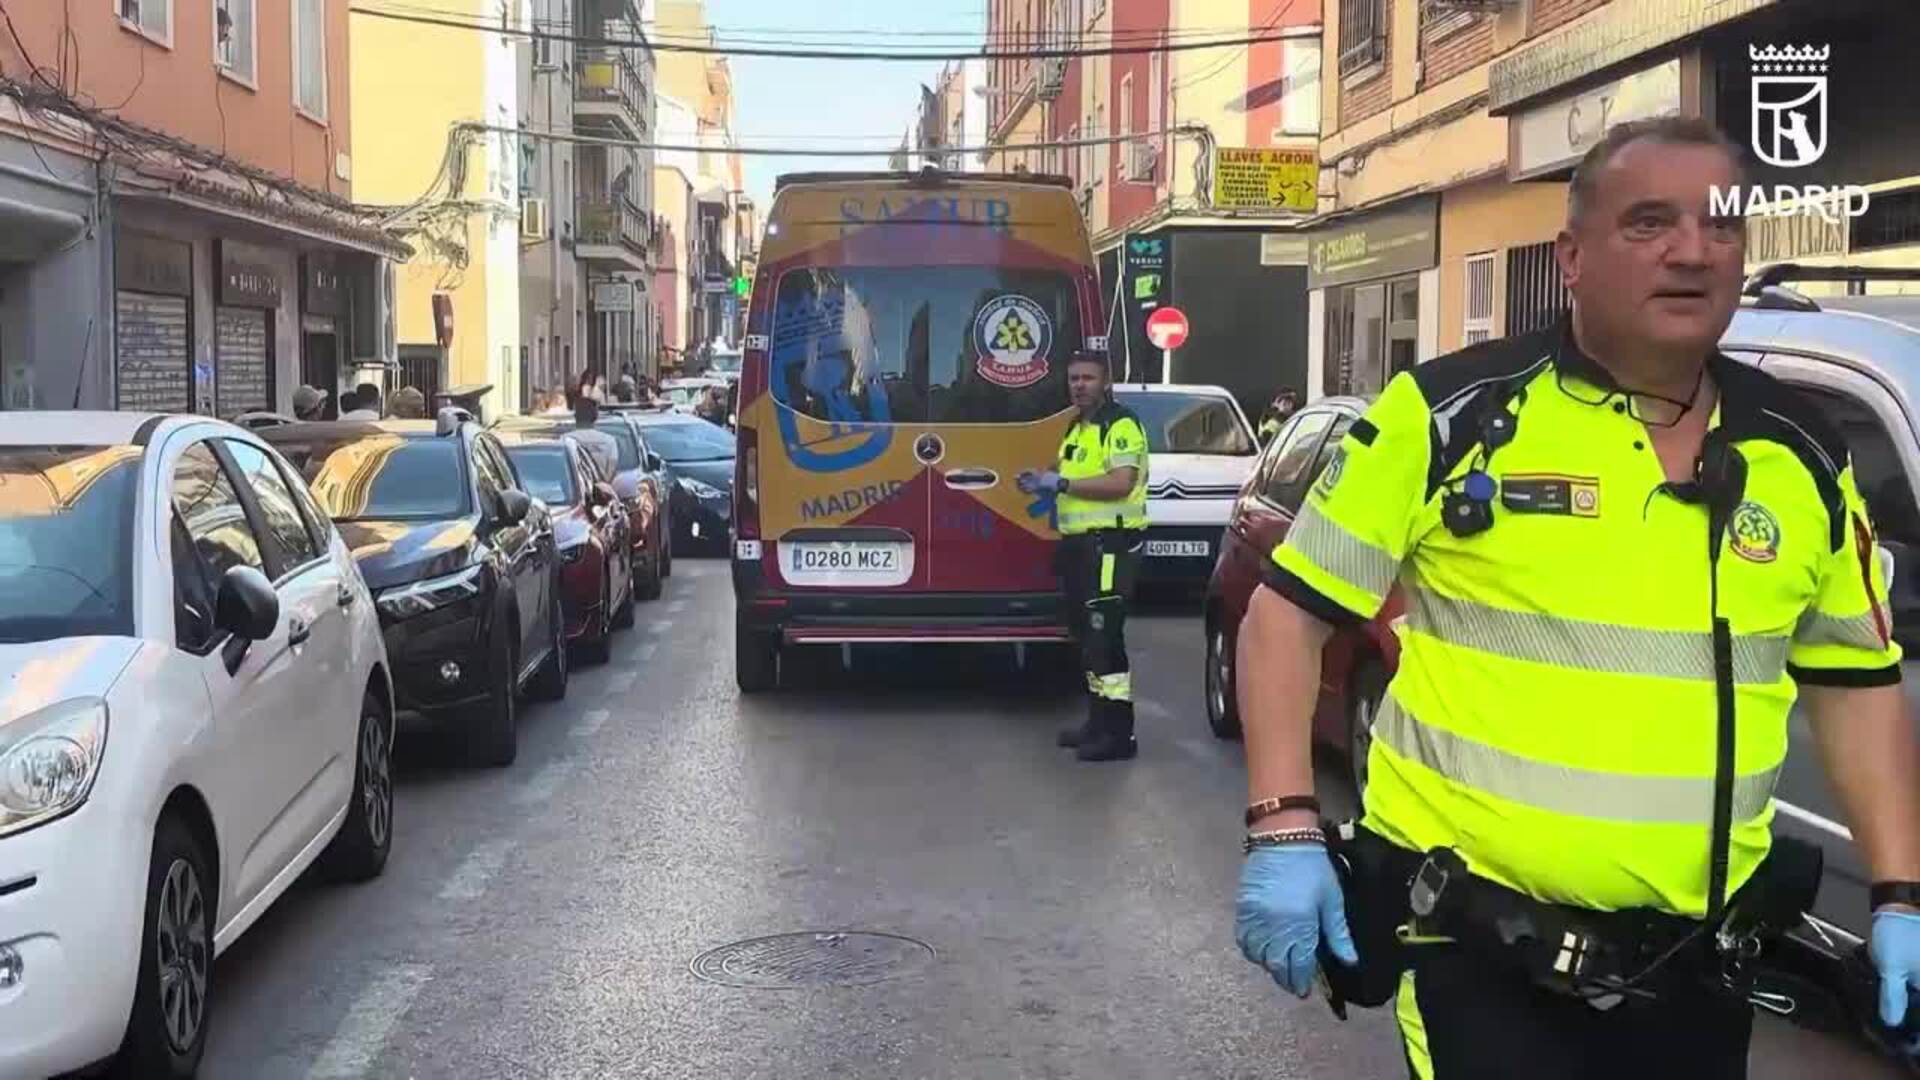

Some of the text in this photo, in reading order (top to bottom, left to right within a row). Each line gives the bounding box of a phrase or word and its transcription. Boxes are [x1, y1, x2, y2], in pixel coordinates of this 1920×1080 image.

[1220, 151, 1263, 164] LLAVES
[1760, 218, 1781, 261] DE
[1786, 208, 1846, 257] VIAJES
[805, 550, 892, 568] 0280 MCZ
